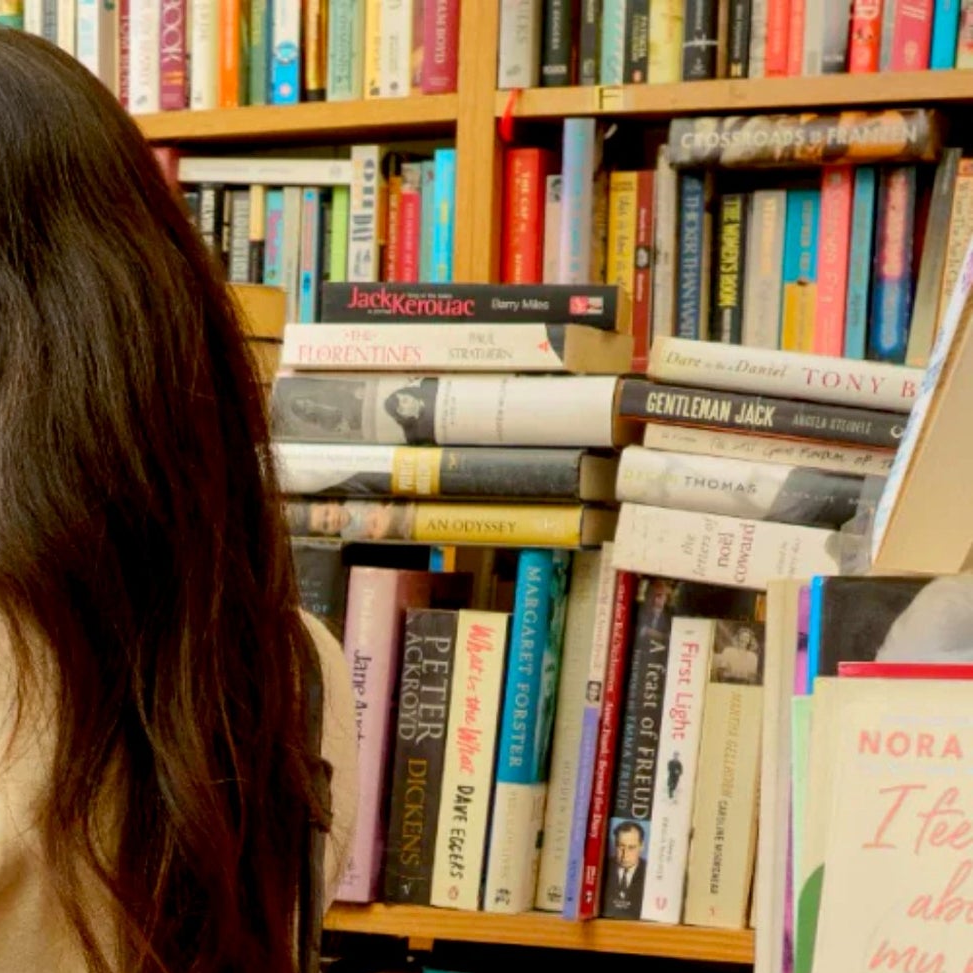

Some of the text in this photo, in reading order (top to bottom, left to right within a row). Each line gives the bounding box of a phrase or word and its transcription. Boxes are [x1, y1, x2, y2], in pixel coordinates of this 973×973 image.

[681, 121, 918, 151] CROSSROADS FRANZEN
[346, 286, 395, 310] Jack
[390, 294, 476, 318] Kerouac
[297, 343, 422, 363] FLORENTINES
[665, 350, 886, 397] Dare Daniel TONY
[645, 391, 776, 428] GENTLEMAN JACK
[683, 475, 758, 495] THOMAS
[427, 518, 517, 534] AN ODYSSEY
[735, 522, 756, 584] coward
[465, 622, 498, 679] What
[507, 566, 544, 768] MARGARET FORSTER
[396, 633, 424, 742] ACKROYD
[415, 635, 452, 745] PETER
[670, 639, 700, 741] First Light
[457, 725, 483, 776] What
[630, 639, 667, 820] A feast of FREUD
[857, 728, 964, 761] NORA
[399, 757, 428, 867] DICKENS
[447, 784, 476, 881] DAVE EGGERS
[861, 783, 927, 850] I
